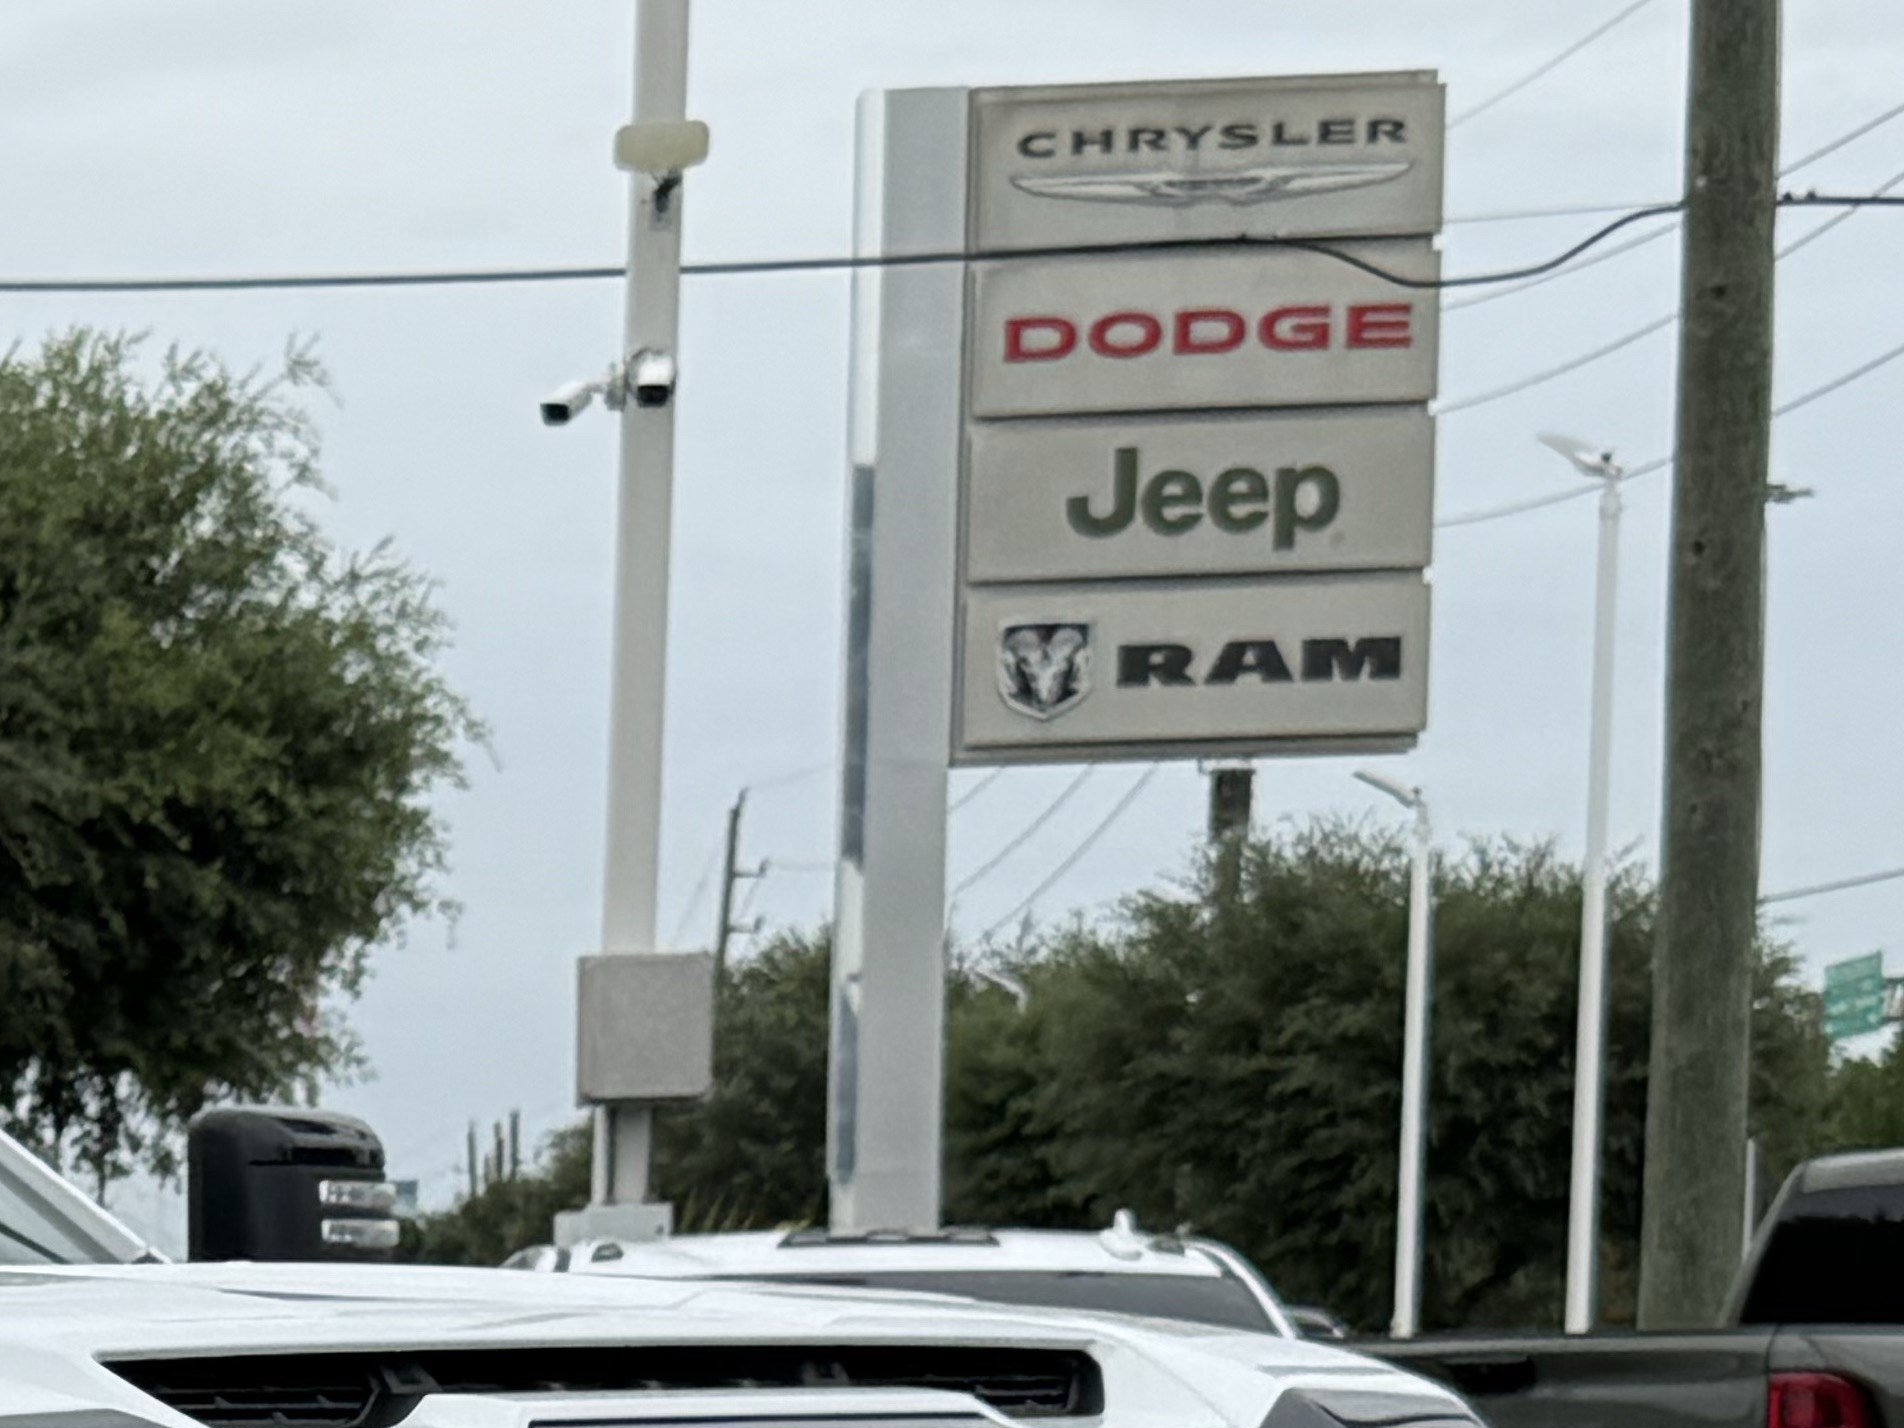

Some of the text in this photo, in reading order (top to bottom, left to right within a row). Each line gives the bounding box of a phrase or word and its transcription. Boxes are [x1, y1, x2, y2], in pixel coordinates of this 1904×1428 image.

[1016, 118, 1409, 159] CHRYSLER
[1003, 303, 1415, 364] DODGE
[1066, 447, 1342, 551] Jeep
[1116, 636, 1403, 689] RAM
